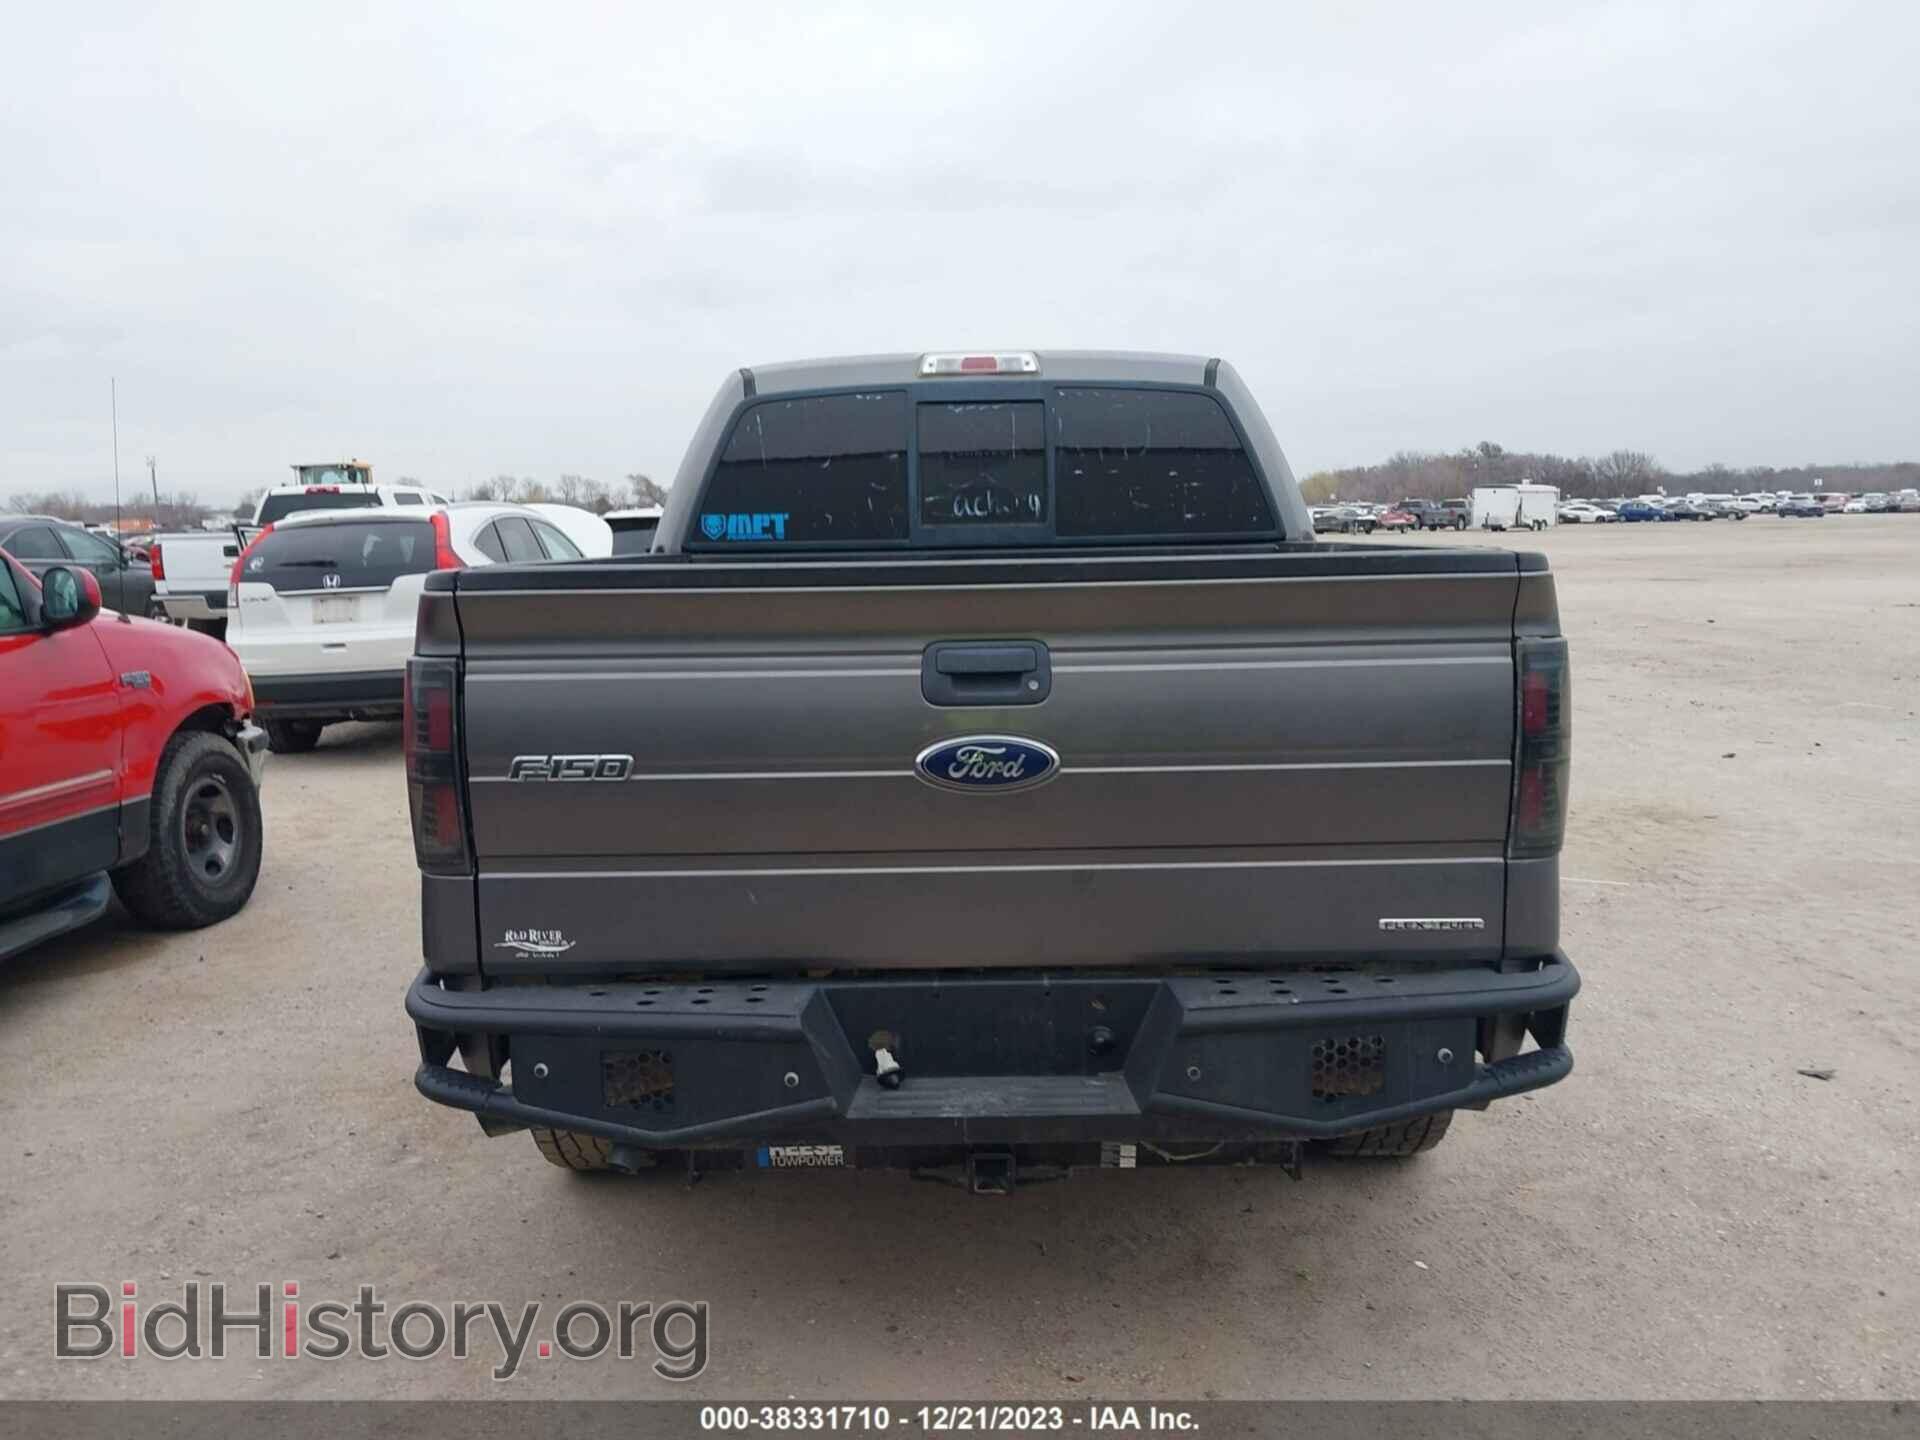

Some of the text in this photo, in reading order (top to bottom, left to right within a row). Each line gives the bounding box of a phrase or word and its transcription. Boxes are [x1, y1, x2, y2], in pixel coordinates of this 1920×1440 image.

[947, 745, 1027, 779] Ford
[528, 928, 563, 943] RIVER
[771, 1154, 845, 1168] TOWPOWER
